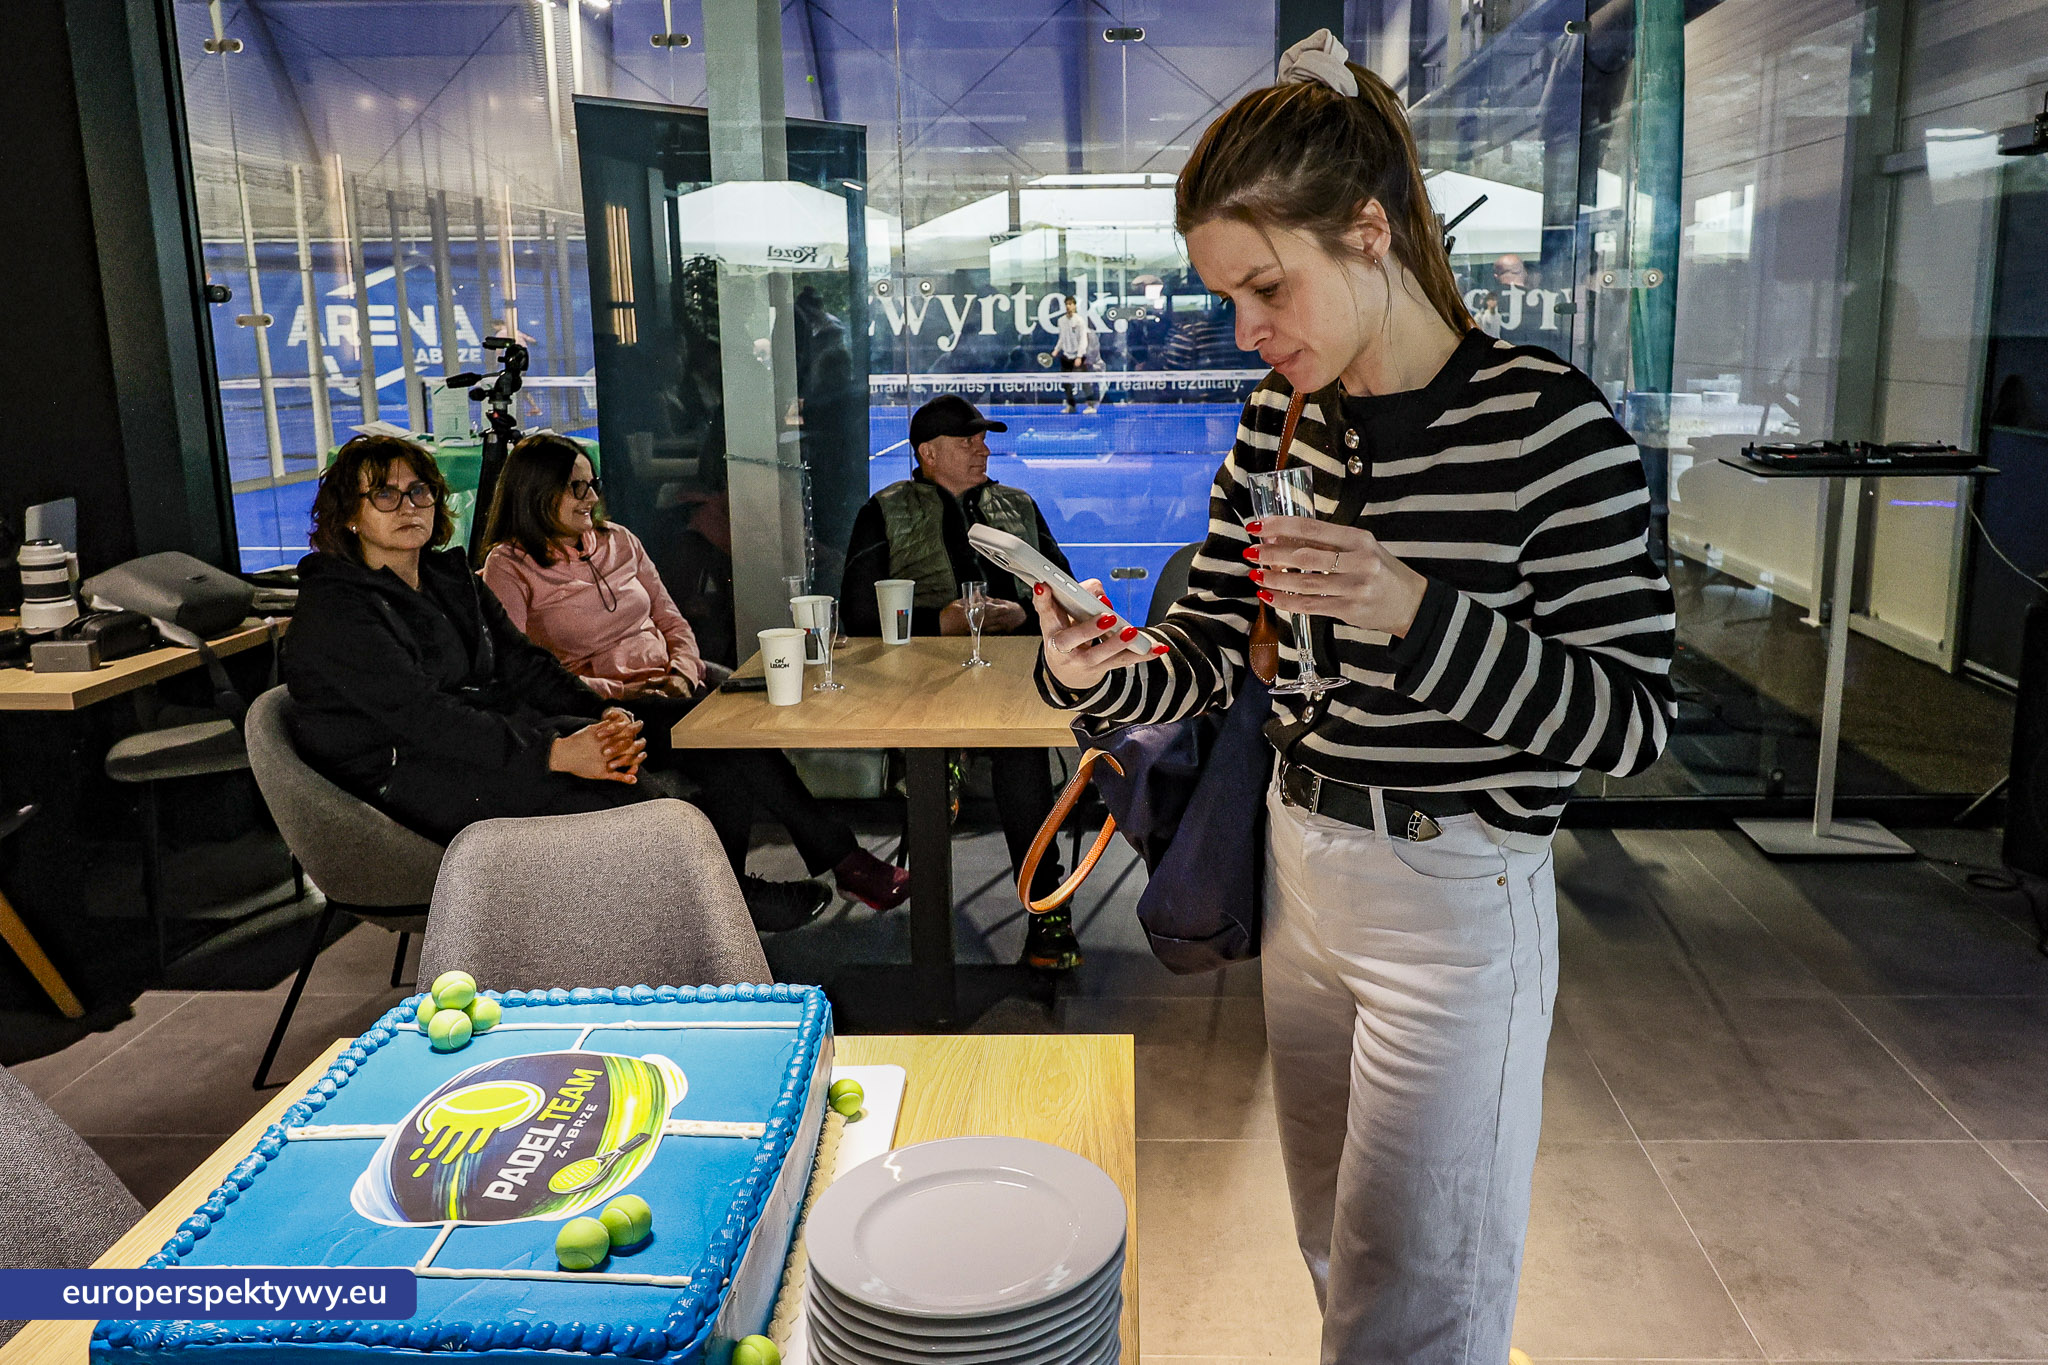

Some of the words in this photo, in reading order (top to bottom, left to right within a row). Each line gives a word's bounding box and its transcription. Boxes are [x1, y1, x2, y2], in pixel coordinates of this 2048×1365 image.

[287, 305, 481, 347] ARENA
[868, 273, 1128, 352] wyrtek.
[412, 348, 481, 363] ABZE
[481, 1120, 564, 1202] PADEL
[536, 1068, 603, 1121] TEAM
[553, 1103, 599, 1160] ZABRZE
